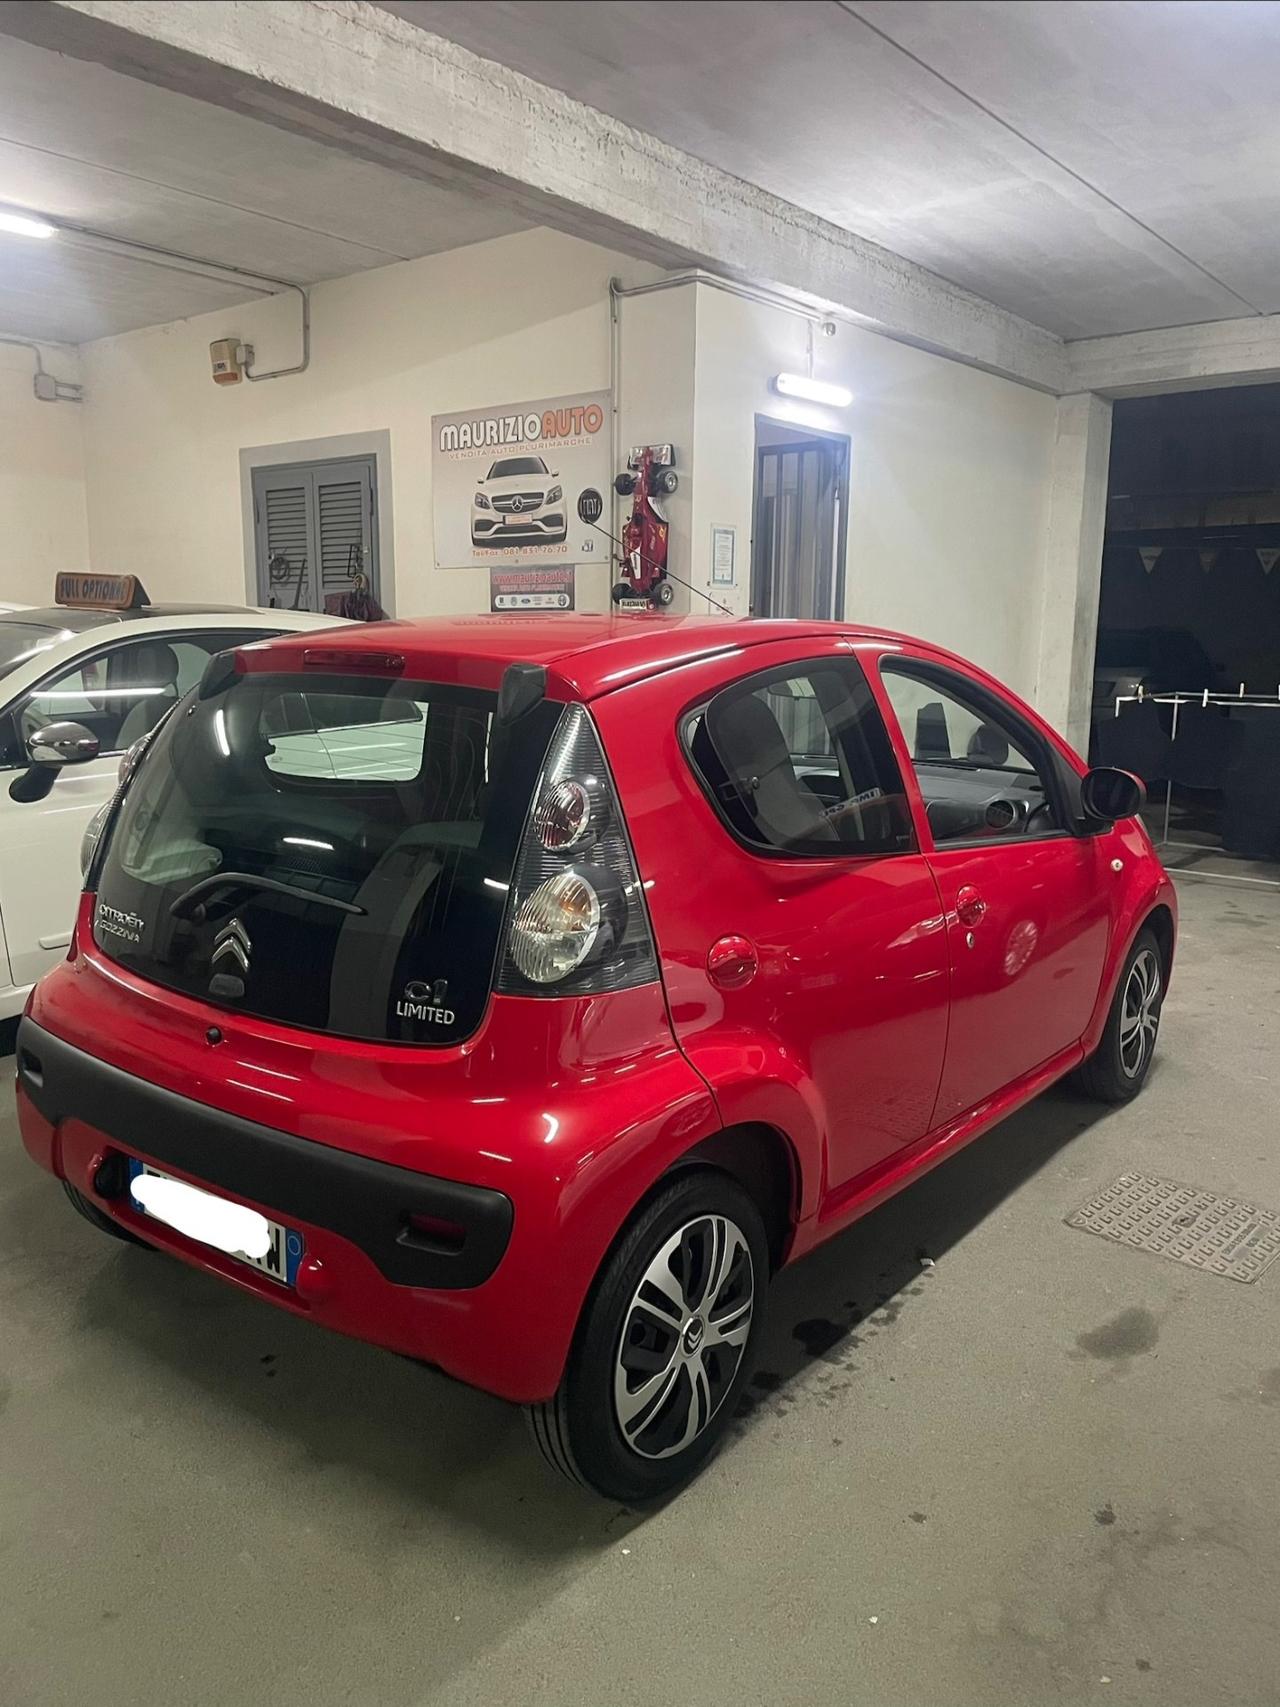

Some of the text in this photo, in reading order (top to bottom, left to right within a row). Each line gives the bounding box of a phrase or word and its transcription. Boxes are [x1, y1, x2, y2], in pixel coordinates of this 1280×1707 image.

[450, 437, 592, 460] VENDITA AUTO PLURIMARCHE
[99, 904, 144, 929] CITROËN
[396, 1000, 455, 1025] LIMITED
